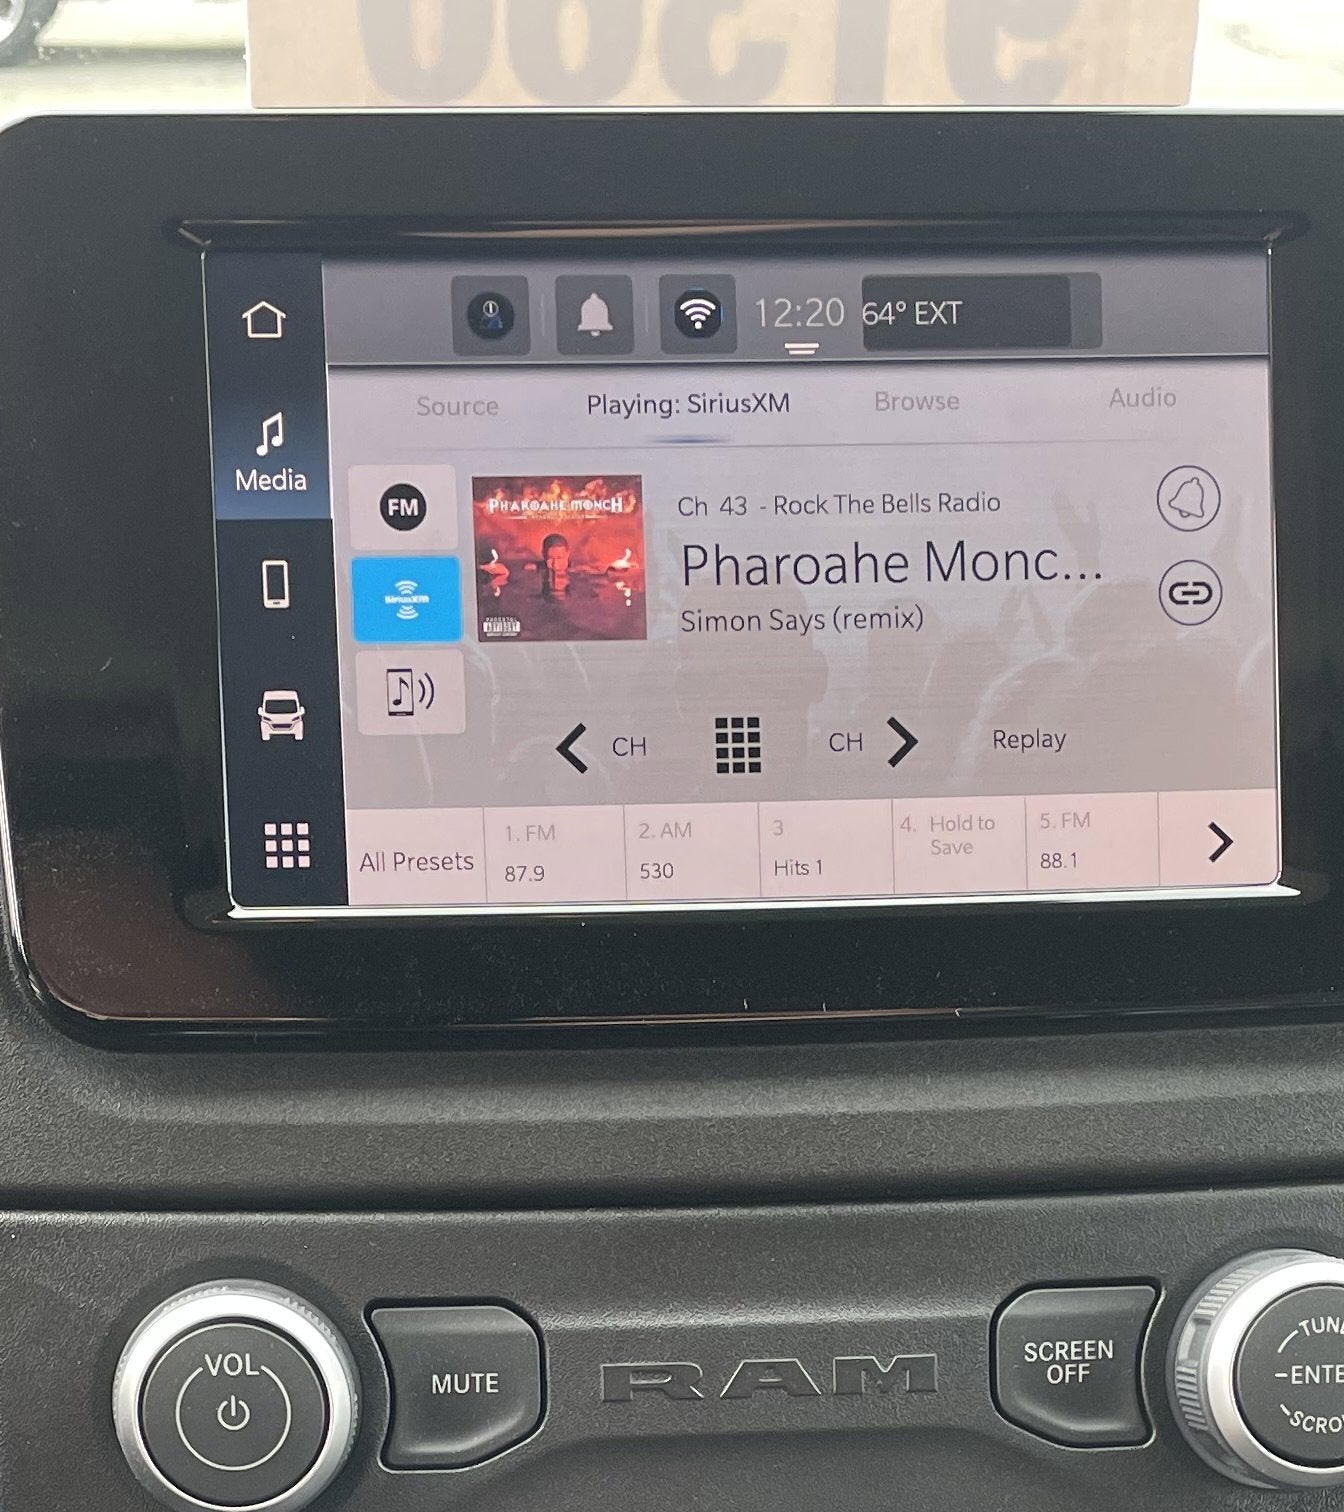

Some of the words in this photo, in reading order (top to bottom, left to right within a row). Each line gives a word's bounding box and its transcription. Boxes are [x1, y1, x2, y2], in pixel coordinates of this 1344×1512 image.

[756, 297, 845, 328] 12:20
[914, 300, 963, 326] EXT
[416, 395, 500, 418] Source
[587, 393, 681, 421] Playing:
[687, 391, 791, 415] SiriusXM
[874, 391, 961, 413] Browse
[1108, 387, 1178, 409] Audio
[234, 468, 308, 492] Media
[386, 497, 420, 518] FM
[677, 496, 708, 517] Ch
[719, 495, 748, 516] 43
[773, 495, 829, 515] Rock
[833, 494, 875, 514] The
[881, 492, 932, 514] Bells
[937, 491, 1001, 513] Radio
[682, 541, 910, 587] Pharoahe
[926, 540, 1103, 583] Monc...
[680, 609, 762, 633] Simon
[768, 607, 827, 637] Says
[832, 604, 925, 633] (remix)
[612, 735, 647, 758] CH
[829, 731, 864, 753] CH
[993, 728, 1067, 753] Replay
[638, 823, 656, 840] 2.
[660, 821, 693, 839] AM
[772, 819, 785, 837] 3
[899, 816, 917, 833] 4.
[929, 814, 974, 832] Hold
[978, 815, 996, 832] to
[1039, 812, 1057, 830] 5.
[1061, 811, 1091, 829] FM
[505, 825, 520, 842] 1.
[525, 824, 556, 842] FM
[929, 837, 975, 857] Save
[359, 851, 387, 873] All
[393, 850, 475, 873] Presets
[639, 861, 675, 880] 530
[773, 857, 811, 877] Hits
[816, 858, 824, 876] 1
[1040, 851, 1079, 870] 88.1
[505, 864, 546, 884] 87.9
[1023, 1339, 1114, 1363] SCREEN
[203, 1353, 261, 1378] VOL
[1046, 1363, 1091, 1385] OFF
[430, 1373, 500, 1396] MUTE
[601, 1353, 939, 1402] RAM
